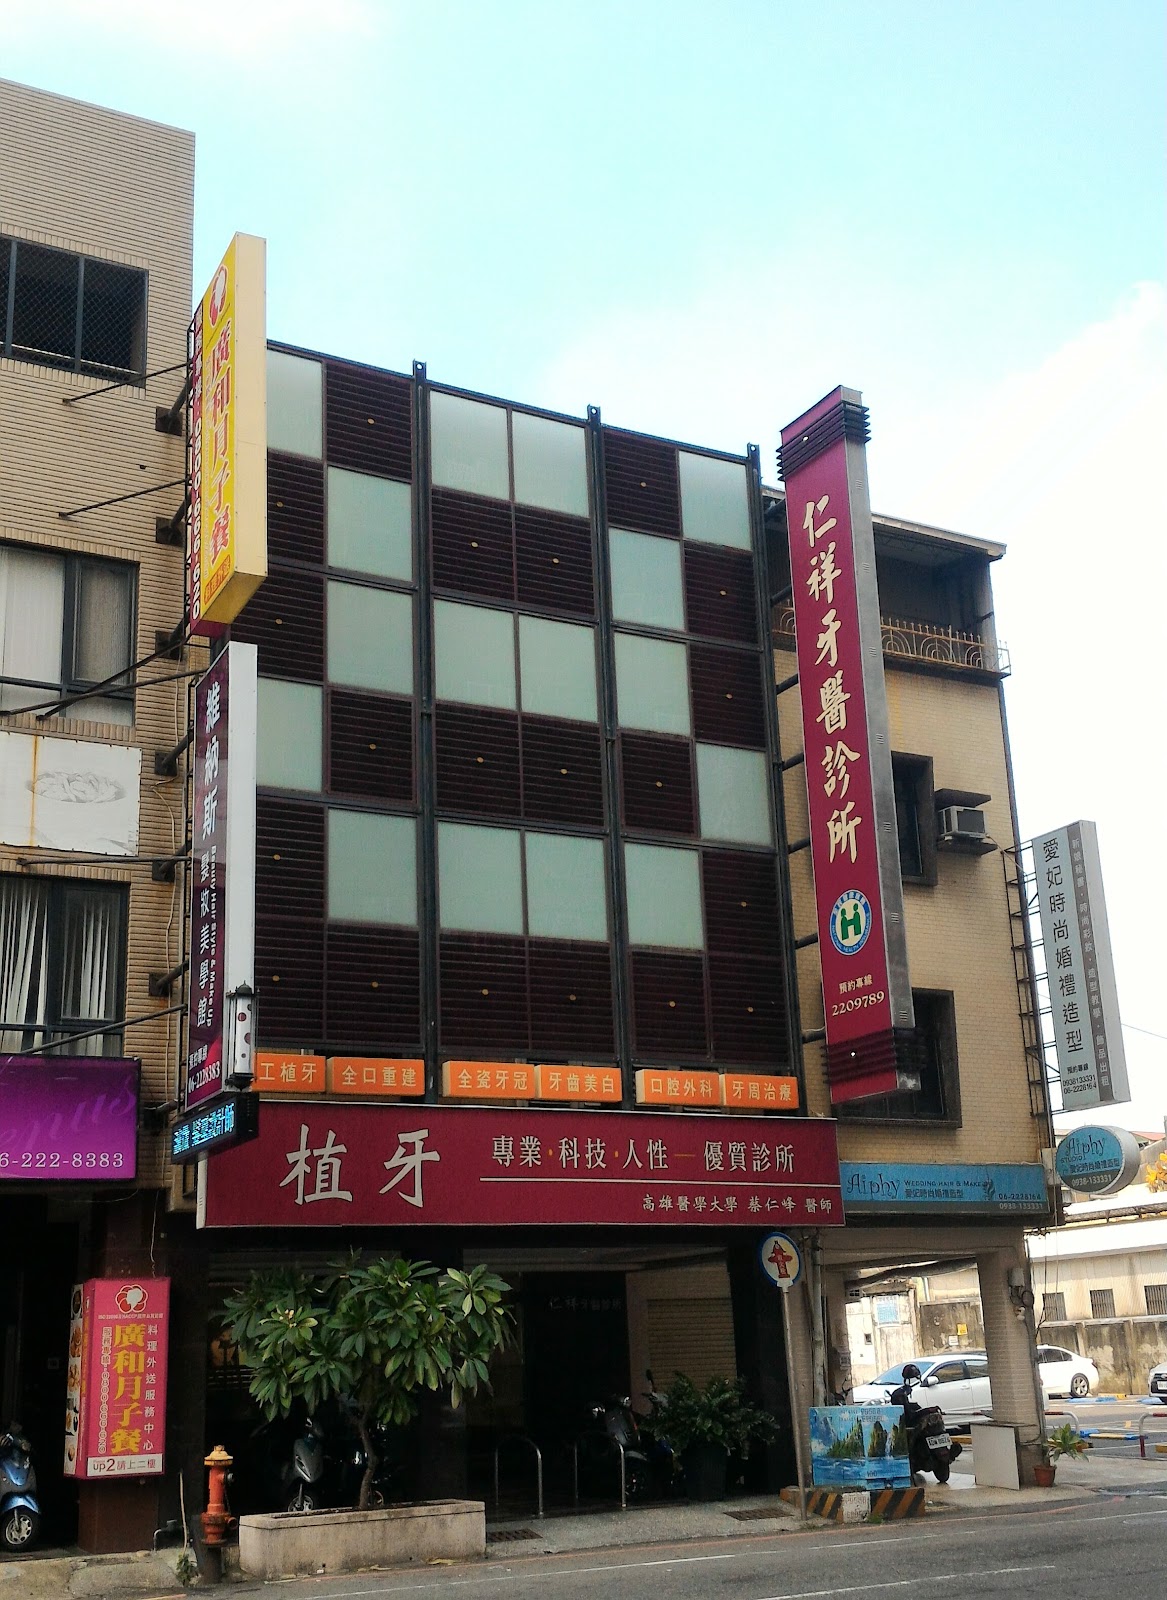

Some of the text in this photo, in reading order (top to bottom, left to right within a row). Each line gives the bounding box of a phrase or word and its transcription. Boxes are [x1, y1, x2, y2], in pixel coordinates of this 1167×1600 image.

[802, 494, 861, 864] 仁祥牙醫診所
[203, 681, 221, 840] 維納斯
[1042, 837, 1083, 1054] 愛妃時尚婚禮造型
[839, 974, 873, 994] 預約專線
[832, 990, 885, 1016] 2209789
[341, 1065, 417, 1088] 全口重建
[457, 1068, 529, 1091] 全瓷牙冠
[548, 1072, 615, 1094] 牙齒美白
[650, 1076, 713, 1098] 口腔外科
[731, 1080, 793, 1101] 牙周治療
[279, 1123, 441, 1209] 植牙
[846, 1173, 900, 1200] Aiphy
[1071, 1174, 1112, 1187] 0938-133331
[642, 1193, 833, 1214] 高雄醫學大學 蔡仁峰 醫師
[111, 1323, 147, 1454] 廣和月子餐
[143, 1324, 159, 1451] 料理外送服務中心
[116, 1458, 156, 1471] 請上二樓
